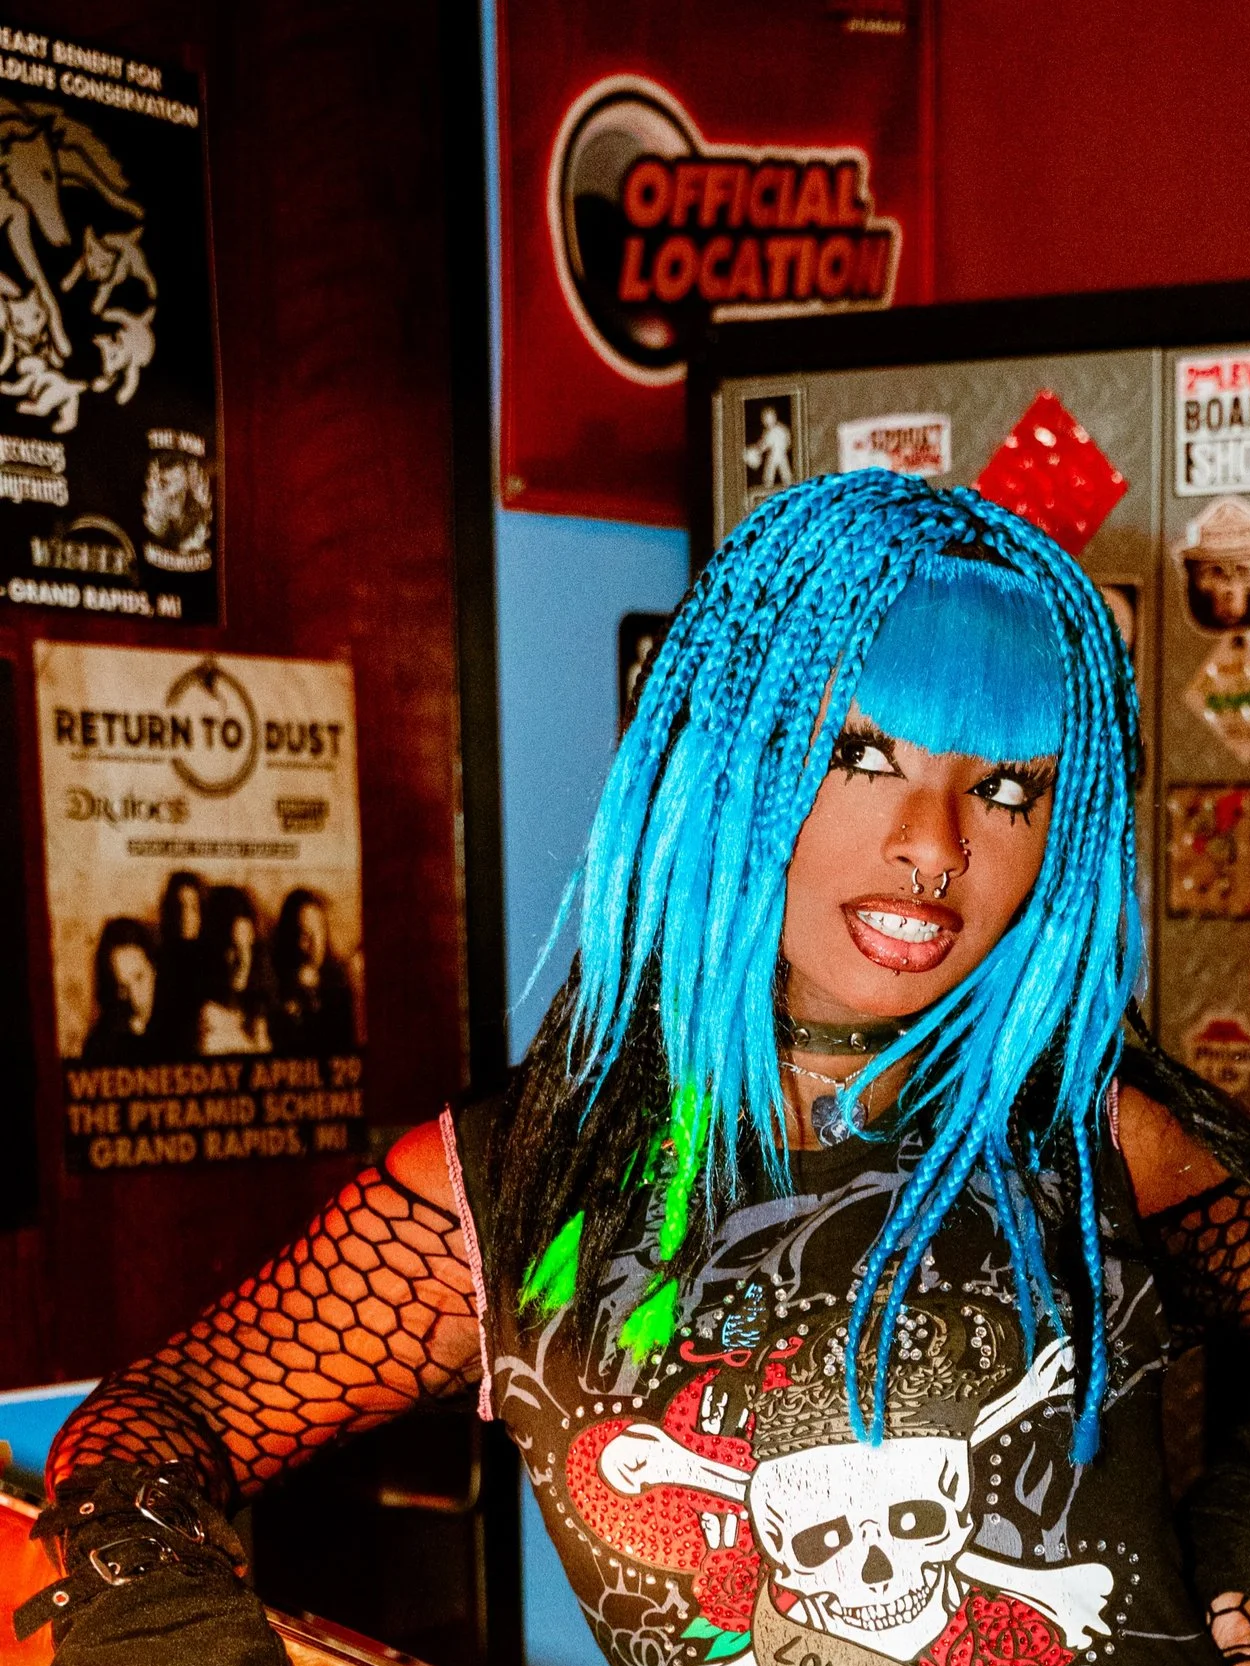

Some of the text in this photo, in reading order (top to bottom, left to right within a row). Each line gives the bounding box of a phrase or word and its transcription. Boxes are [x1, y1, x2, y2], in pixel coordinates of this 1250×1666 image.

[52, 39, 123, 80] BENEFIT
[126, 60, 162, 92] FOR
[0, 54, 199, 129] LDLIFE CONSERVATION
[624, 160, 868, 229] OFFICIAL
[618, 234, 891, 303] LOCATION
[8, 577, 81, 608] GRAND
[54, 708, 341, 756] RETURN TO DUST
[67, 1063, 241, 1099] WEDNESDAY
[251, 1058, 322, 1089] APRIL
[68, 1089, 364, 1136] THE PYRAMID SCHEME
[89, 1132, 197, 1169] GRAND
